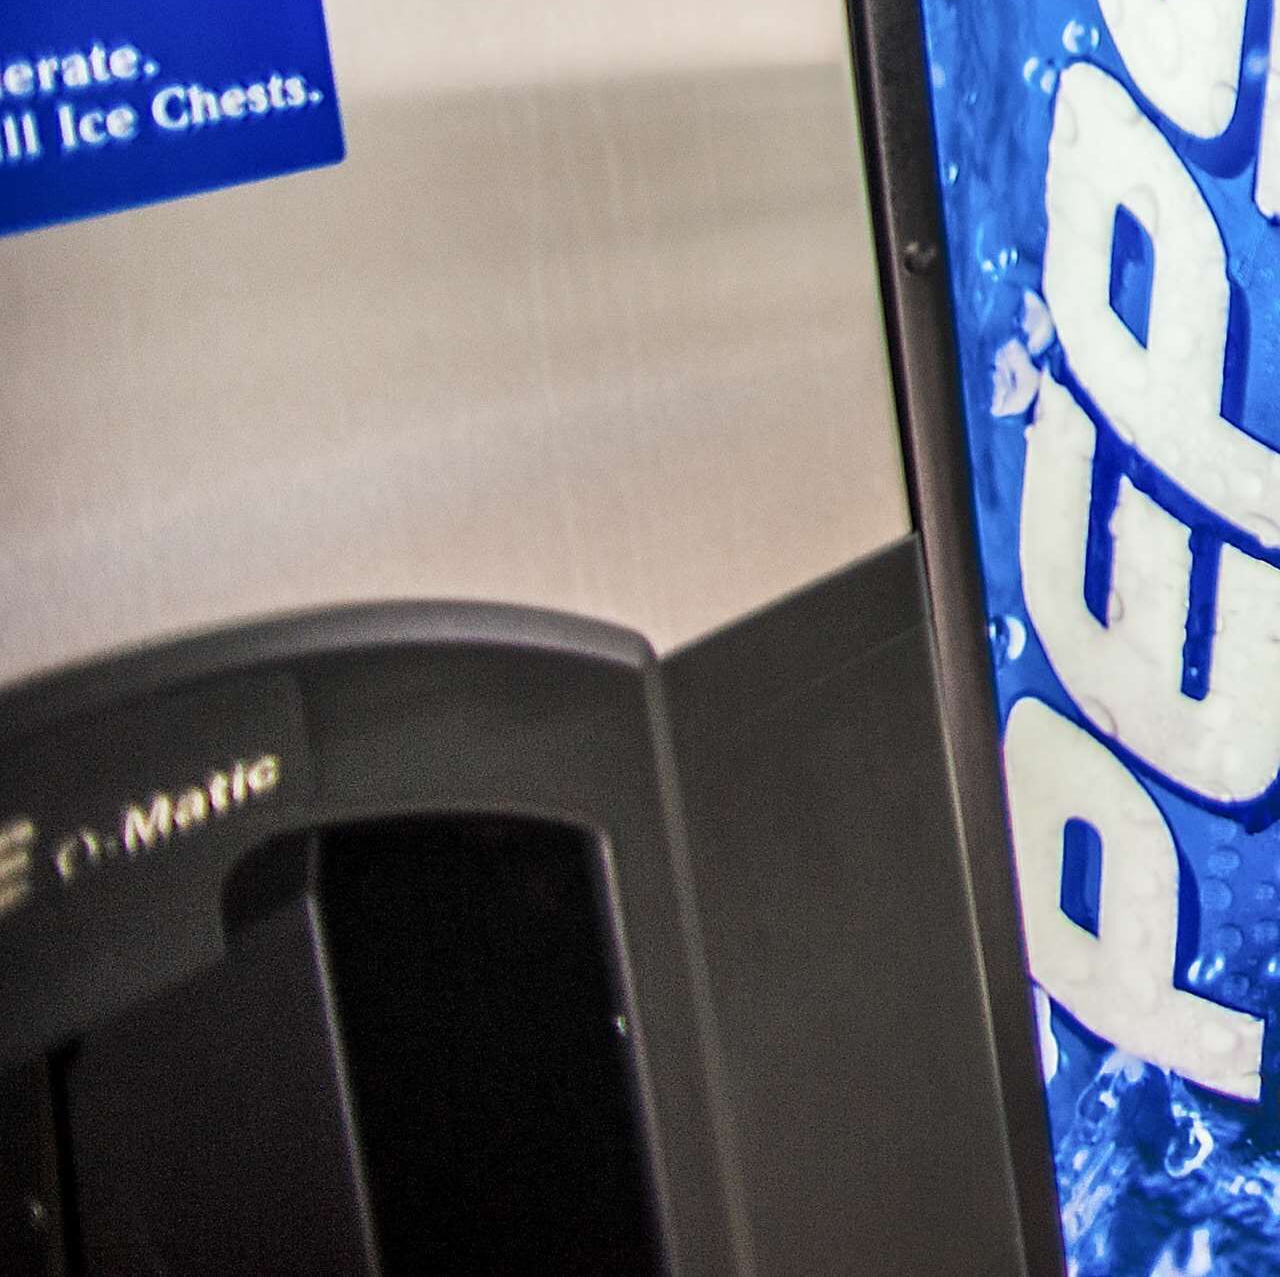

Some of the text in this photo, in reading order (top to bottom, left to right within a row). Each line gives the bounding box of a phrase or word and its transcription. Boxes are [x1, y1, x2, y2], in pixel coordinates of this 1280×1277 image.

[0, 41, 157, 98] erate.
[0, 72, 323, 161] ll Ice Chests.
